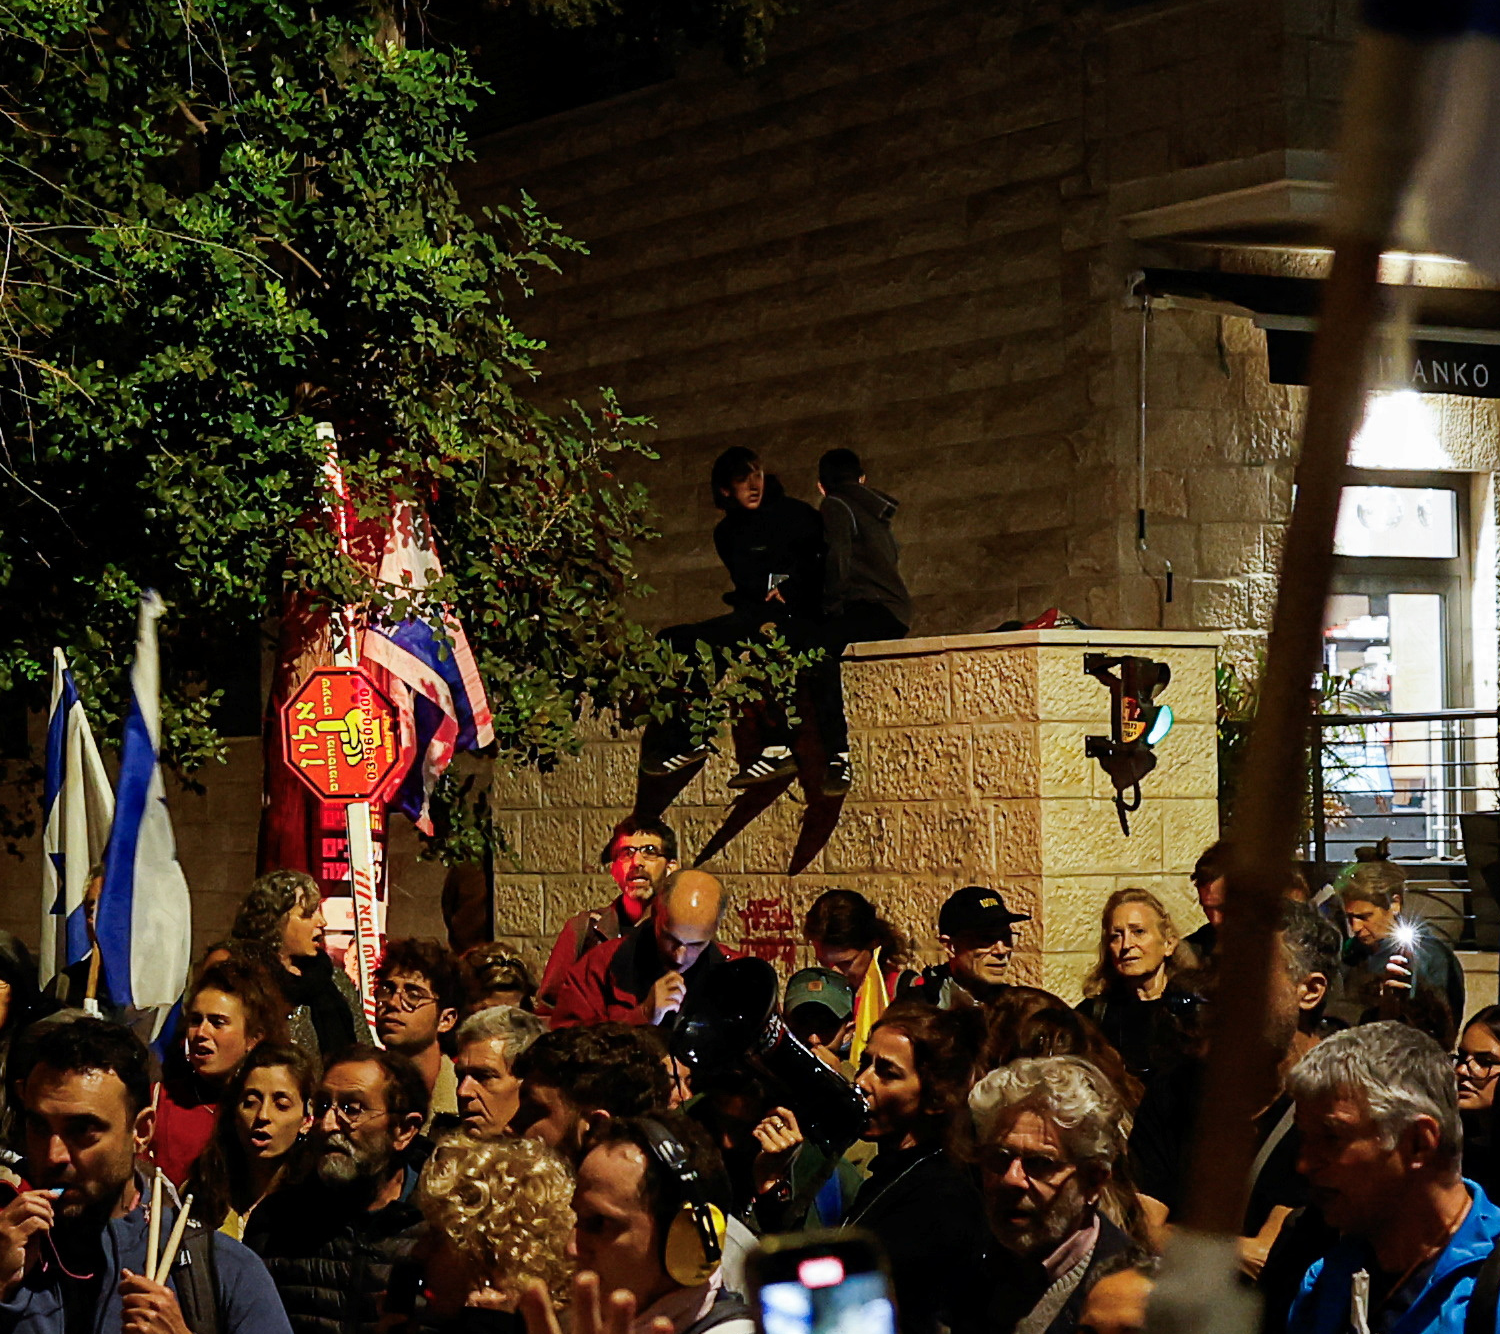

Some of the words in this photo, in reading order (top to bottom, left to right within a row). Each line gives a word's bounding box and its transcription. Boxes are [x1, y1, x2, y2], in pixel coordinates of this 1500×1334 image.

[1378, 355, 1489, 388] ANKO
[321, 677, 333, 716] שערים
[291, 701, 326, 768] אלון
[326, 735, 339, 792] ומחסומים
[358, 903, 373, 938] אלון
